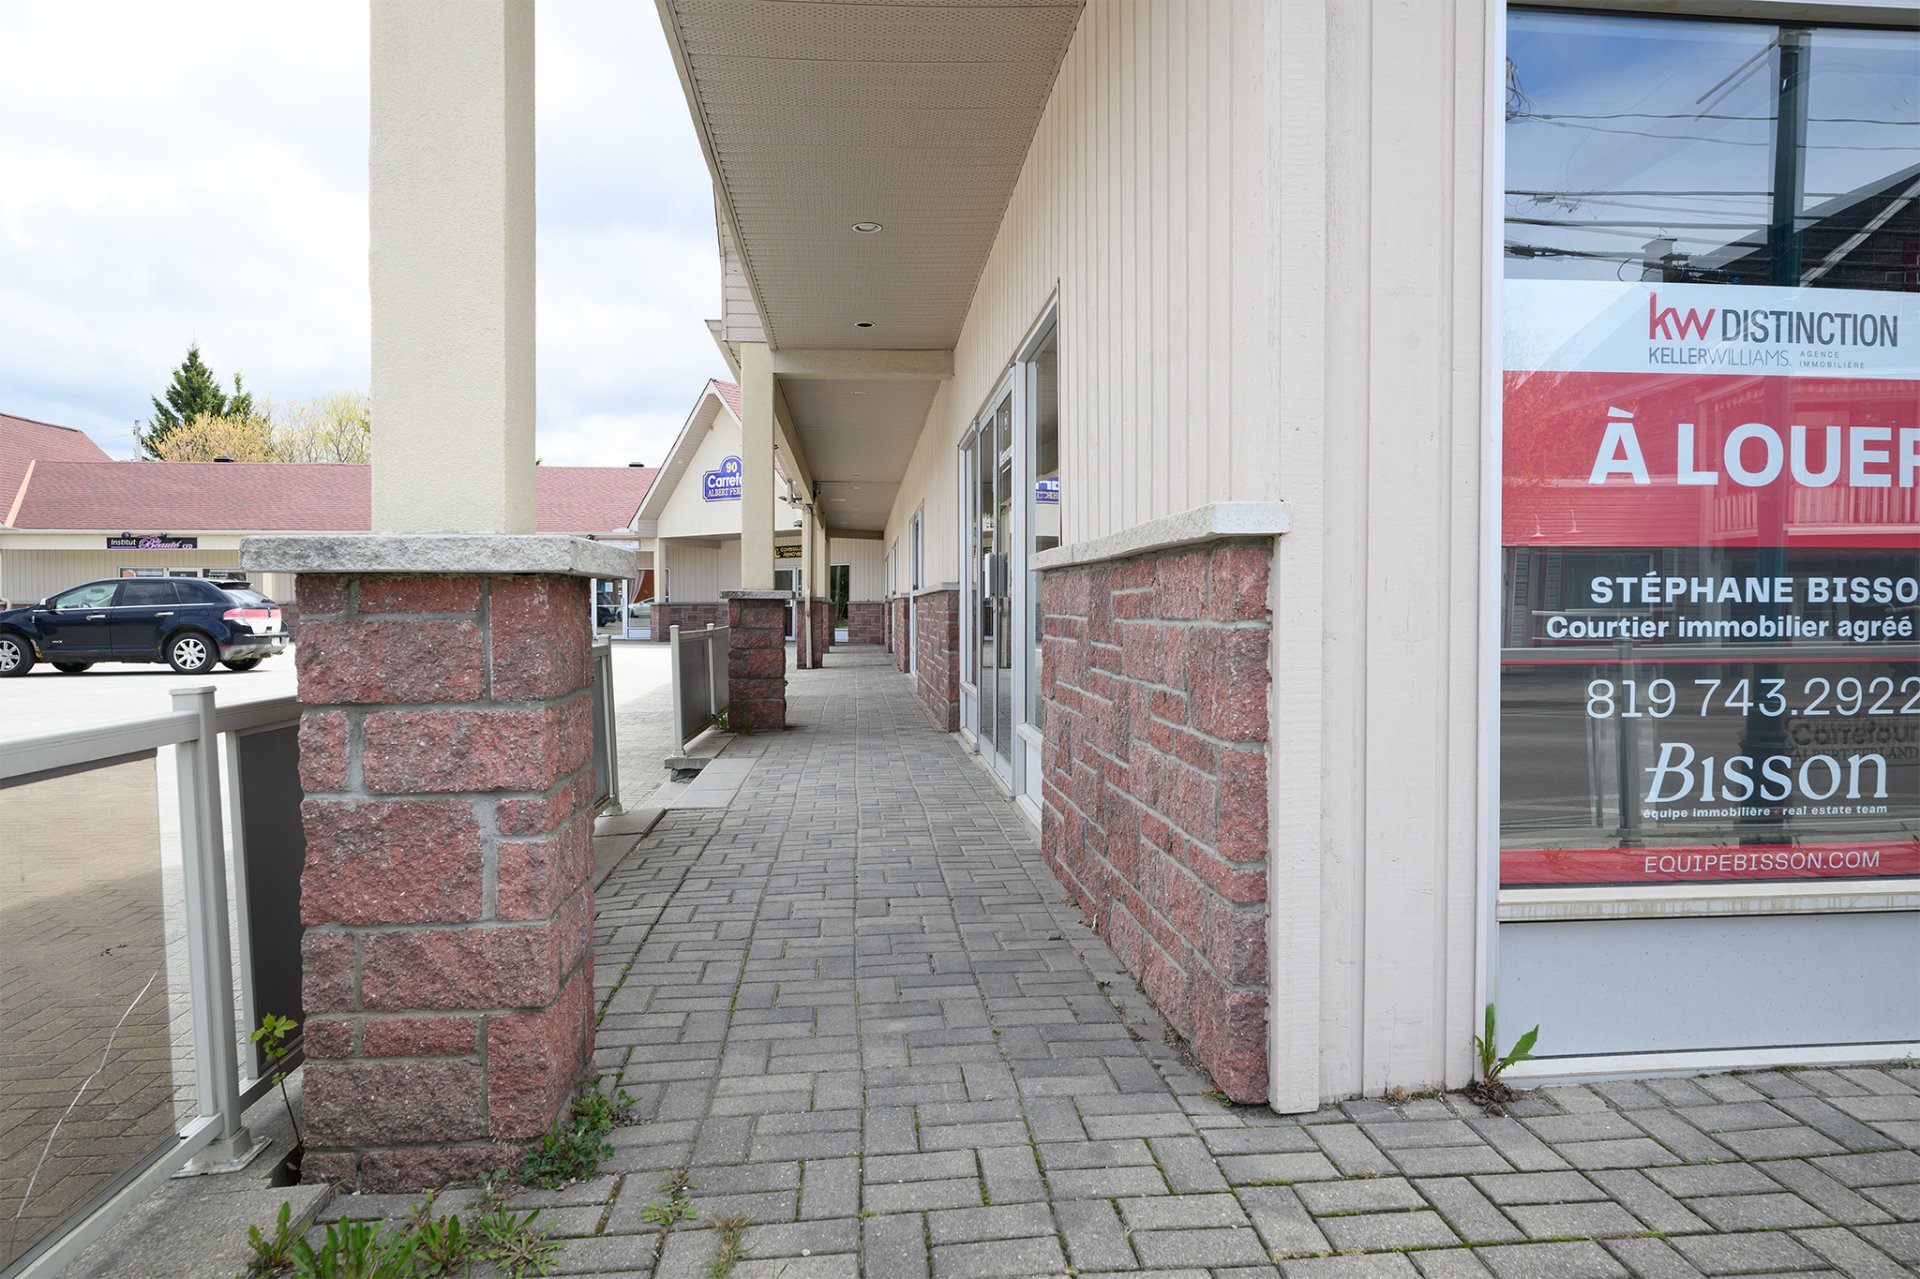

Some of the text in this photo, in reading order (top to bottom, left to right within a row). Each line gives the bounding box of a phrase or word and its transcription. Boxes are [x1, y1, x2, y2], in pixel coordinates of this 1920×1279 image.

[1649, 292, 1898, 347] kw DISTINCTION
[1799, 350, 1840, 359] AGENCE
[1799, 360, 1865, 369] IMMOBILIÈRE
[1588, 405, 1651, 485] À
[726, 462, 737, 473] 90
[1590, 571, 1919, 604] STÉPHANE BISSO
[1546, 614, 1913, 642] Courtier immobilier agréé
[1586, 676, 1920, 719] 819 743.2922
[1643, 804, 1888, 821] équipe immobilière real estate team
[1644, 851, 1880, 873] EQUIPEBISSON.COM
